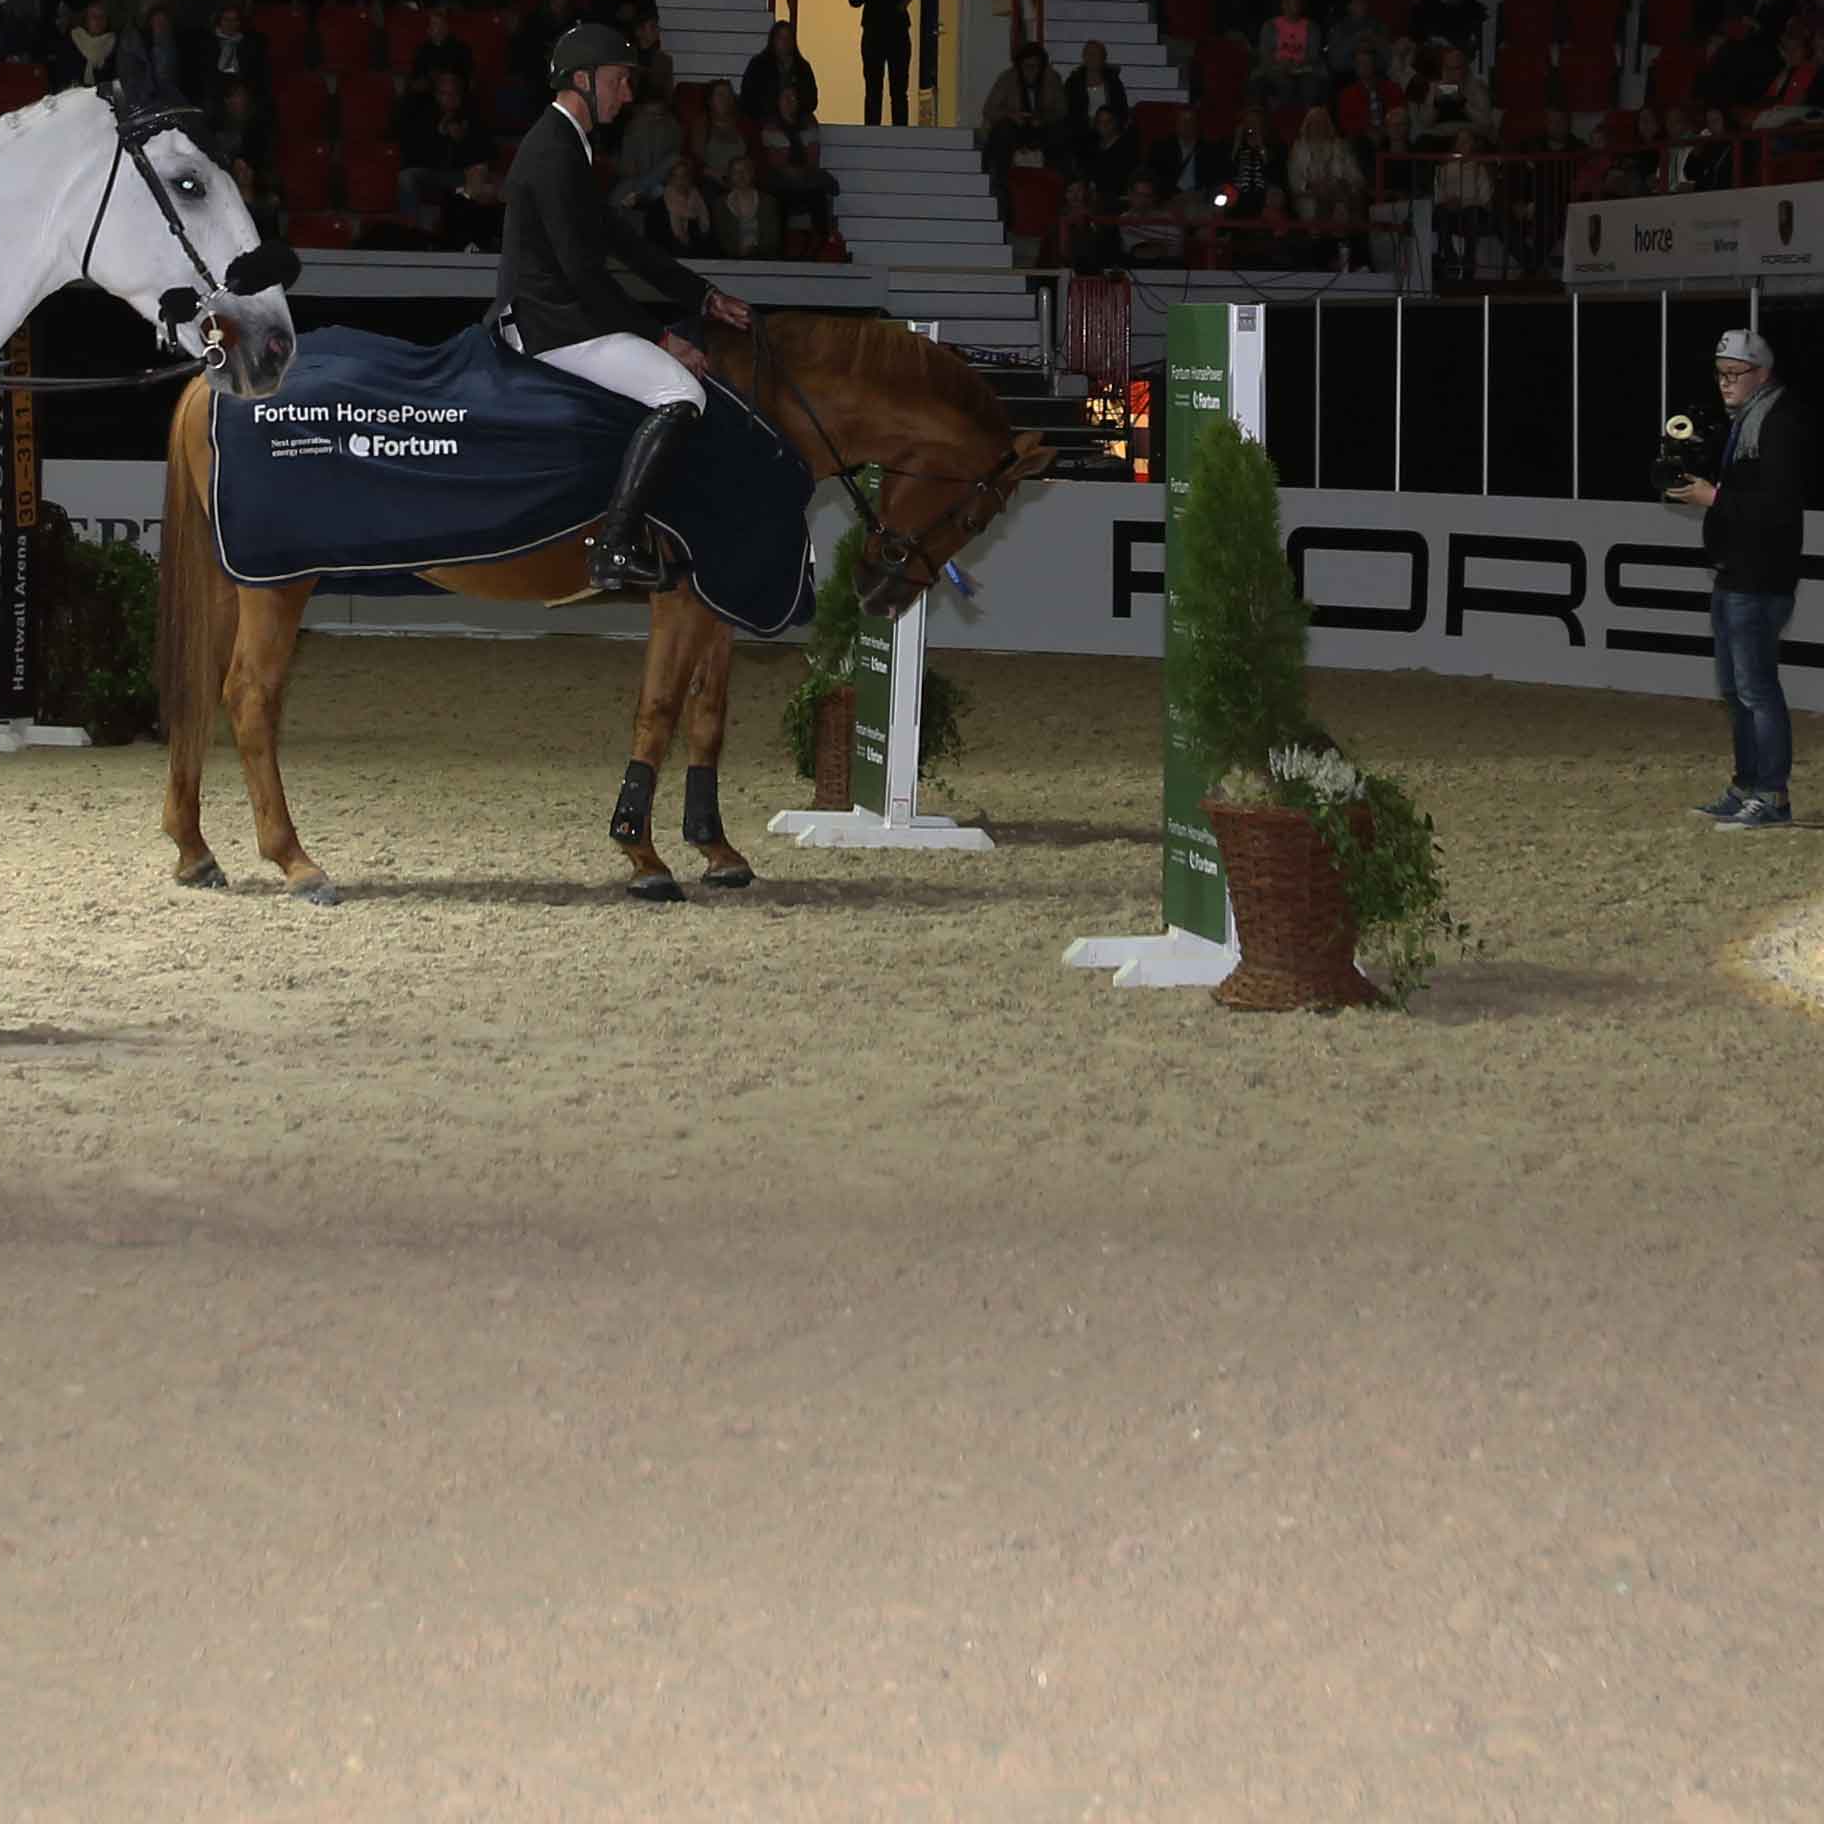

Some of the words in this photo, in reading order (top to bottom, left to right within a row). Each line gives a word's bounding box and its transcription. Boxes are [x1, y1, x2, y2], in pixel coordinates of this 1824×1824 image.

[1633, 223, 1674, 255] horze
[253, 403, 330, 424] Fortum
[336, 402, 469, 424] HorsePower
[299, 445, 334, 457] company
[372, 435, 459, 457] Fortum
[15, 534, 27, 596] Arena
[12, 601, 26, 692] Hartwall
